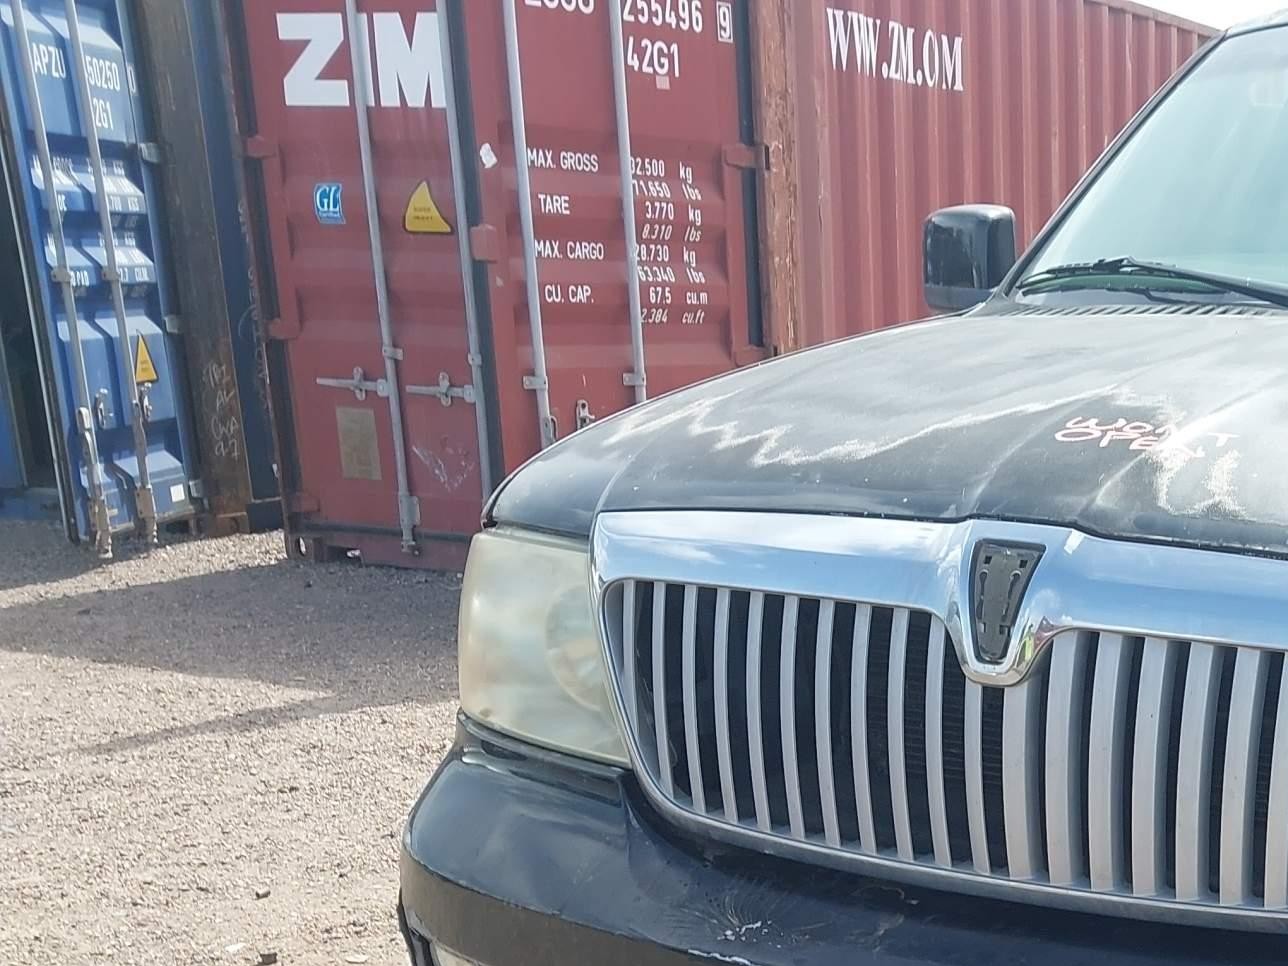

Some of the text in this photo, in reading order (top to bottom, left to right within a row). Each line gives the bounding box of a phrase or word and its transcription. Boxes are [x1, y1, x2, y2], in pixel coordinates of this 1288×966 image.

[623, 0, 703, 33] 255496
[718, 6, 730, 39] 9
[31, 42, 66, 79] APZU
[84, 55, 121, 92] 50250
[276, 12, 447, 108] ZIM
[627, 36, 680, 78] 42G1
[92, 97, 114, 130] 2G1
[527, 148, 556, 169] MAX.
[560, 151, 599, 172] GROSS
[679, 161, 693, 184] kg
[316, 185, 340, 211] GL
[682, 183, 702, 201] lbs
[538, 193, 702, 227] TARE 3.770 kg
[641, 223, 702, 242] 8.310 lbs
[534, 239, 563, 259] MAX.
[567, 242, 605, 260] CARGO
[683, 246, 696, 267] kg
[686, 267, 706, 284] lbs
[545, 284, 708, 305] CU. CAP. 67.5 cu.m
[682, 310, 705, 324] cu.ft
